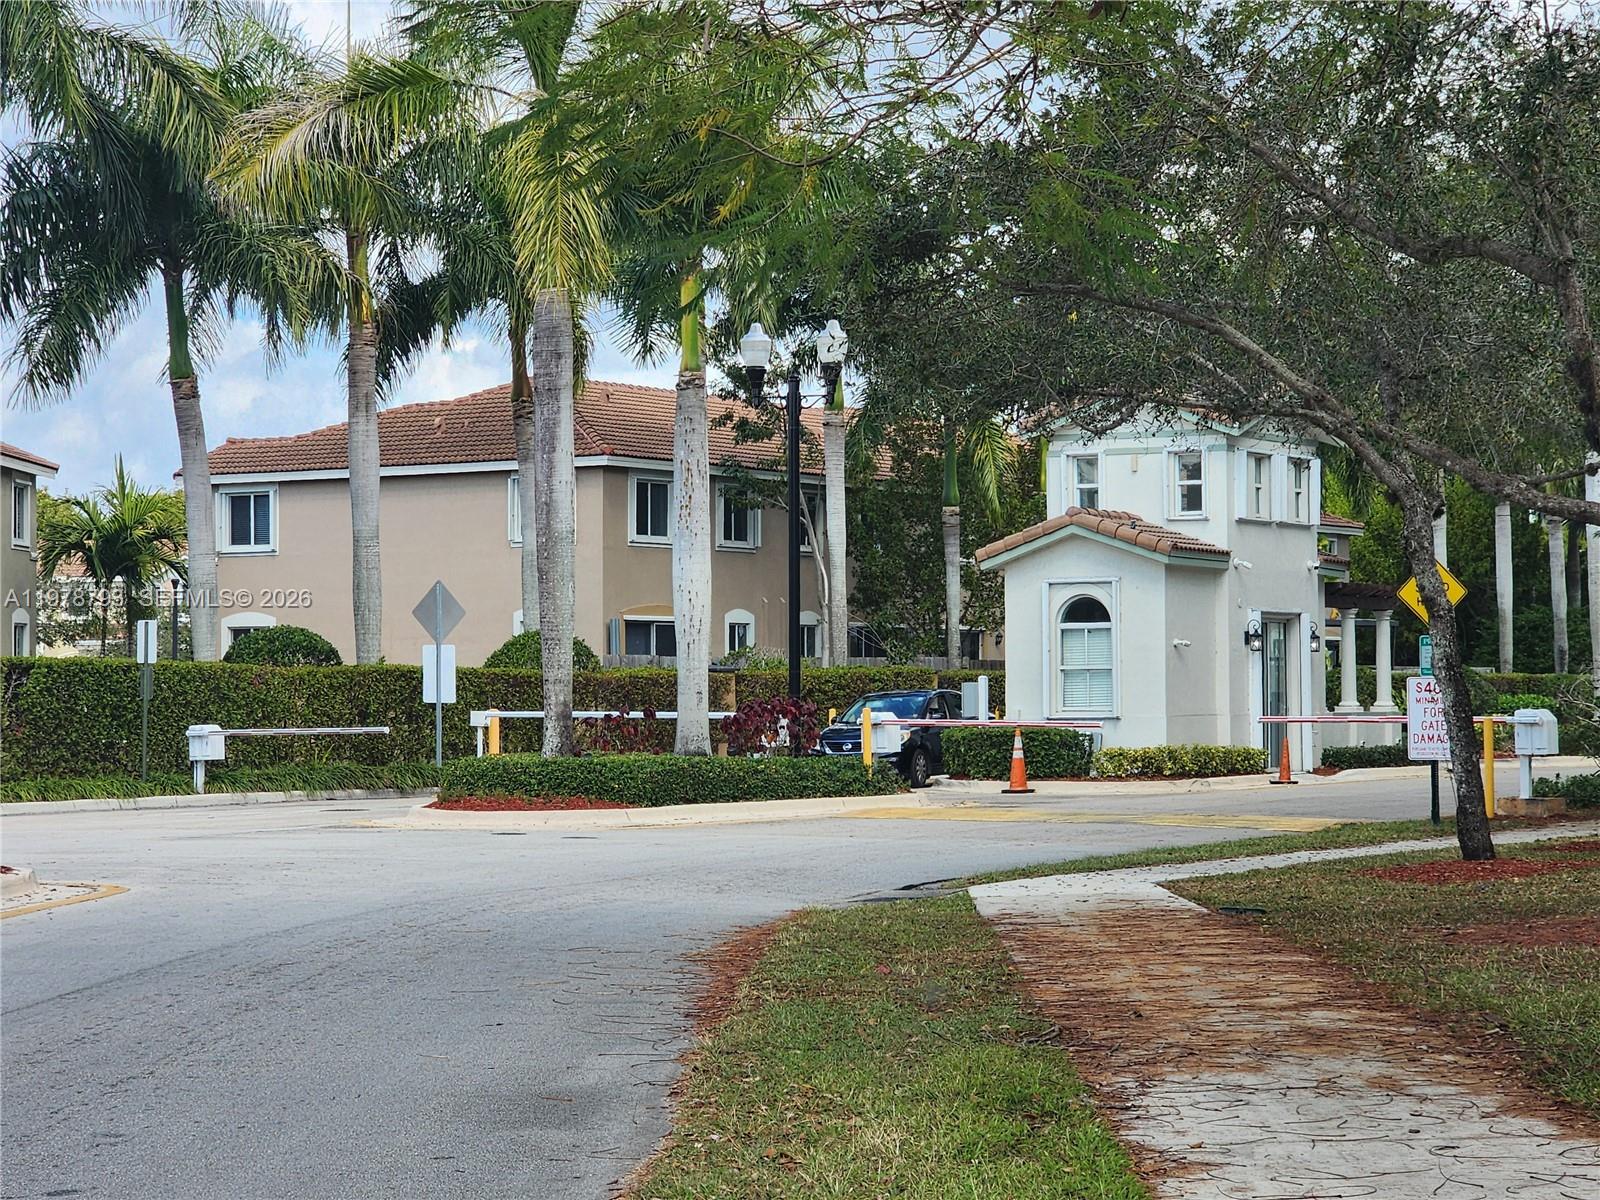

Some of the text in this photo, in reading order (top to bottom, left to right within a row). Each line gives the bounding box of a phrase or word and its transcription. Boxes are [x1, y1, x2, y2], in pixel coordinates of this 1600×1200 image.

[1423, 707, 1446, 718] FOR
[1421, 720, 1448, 731] GATE
[1413, 733, 1449, 744] DAMAG
